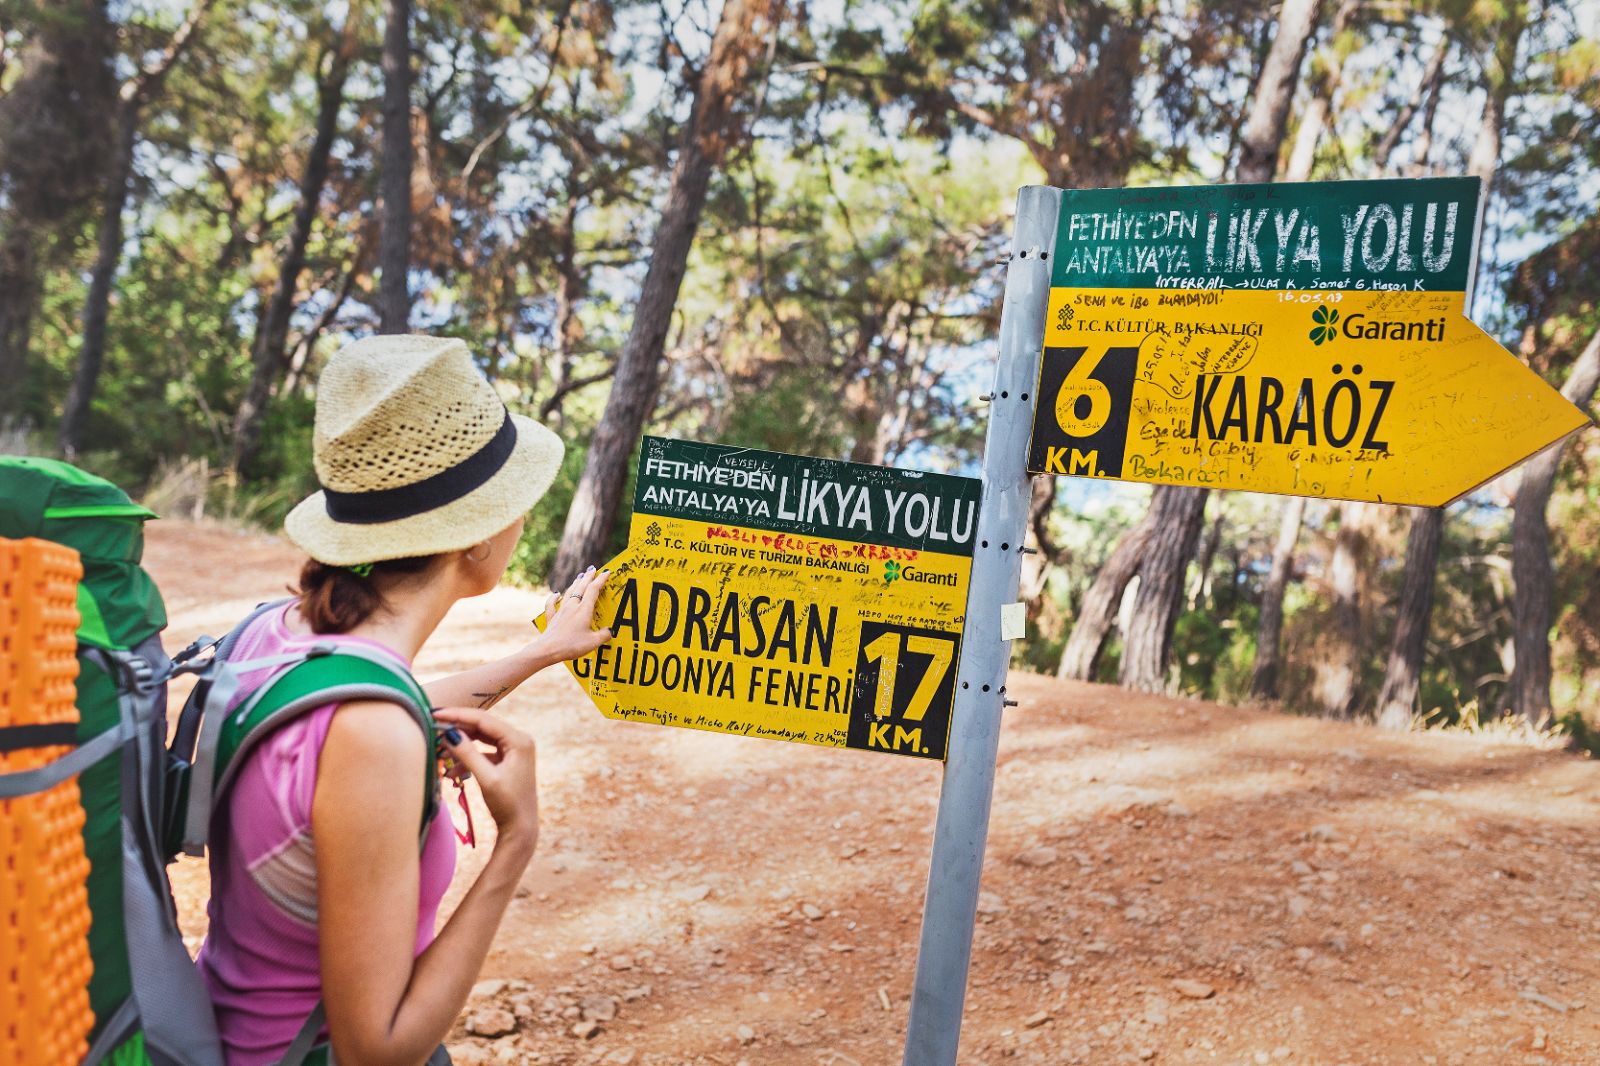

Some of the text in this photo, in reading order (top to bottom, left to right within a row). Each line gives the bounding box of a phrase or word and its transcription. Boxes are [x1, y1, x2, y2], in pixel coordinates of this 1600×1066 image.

[1340, 202, 1459, 274] YOLU
[1065, 245, 1191, 274] ANTALYA'YA
[1076, 317, 1263, 337] T.C. KÜLTÜR BAKANLIĞI
[1342, 313, 1446, 343] Garanti
[1055, 347, 1111, 437] 6
[1190, 363, 1396, 451] KARAÖZ
[1045, 446, 1106, 477] KM.
[642, 485, 771, 518] ANTALYA'YA
[645, 458, 976, 544] FETHİYE'DEN LİKYA YOLU
[663, 537, 870, 575] T.C. KÜLTÜR VE TURİZM BAKANLIĞI
[901, 565, 958, 588] Garanti
[612, 577, 839, 668] ADRASAN
[572, 643, 735, 700] GELİDONYA
[748, 667, 853, 715] FENERİ
[863, 632, 955, 722] 17
[868, 721, 929, 755] KM.
